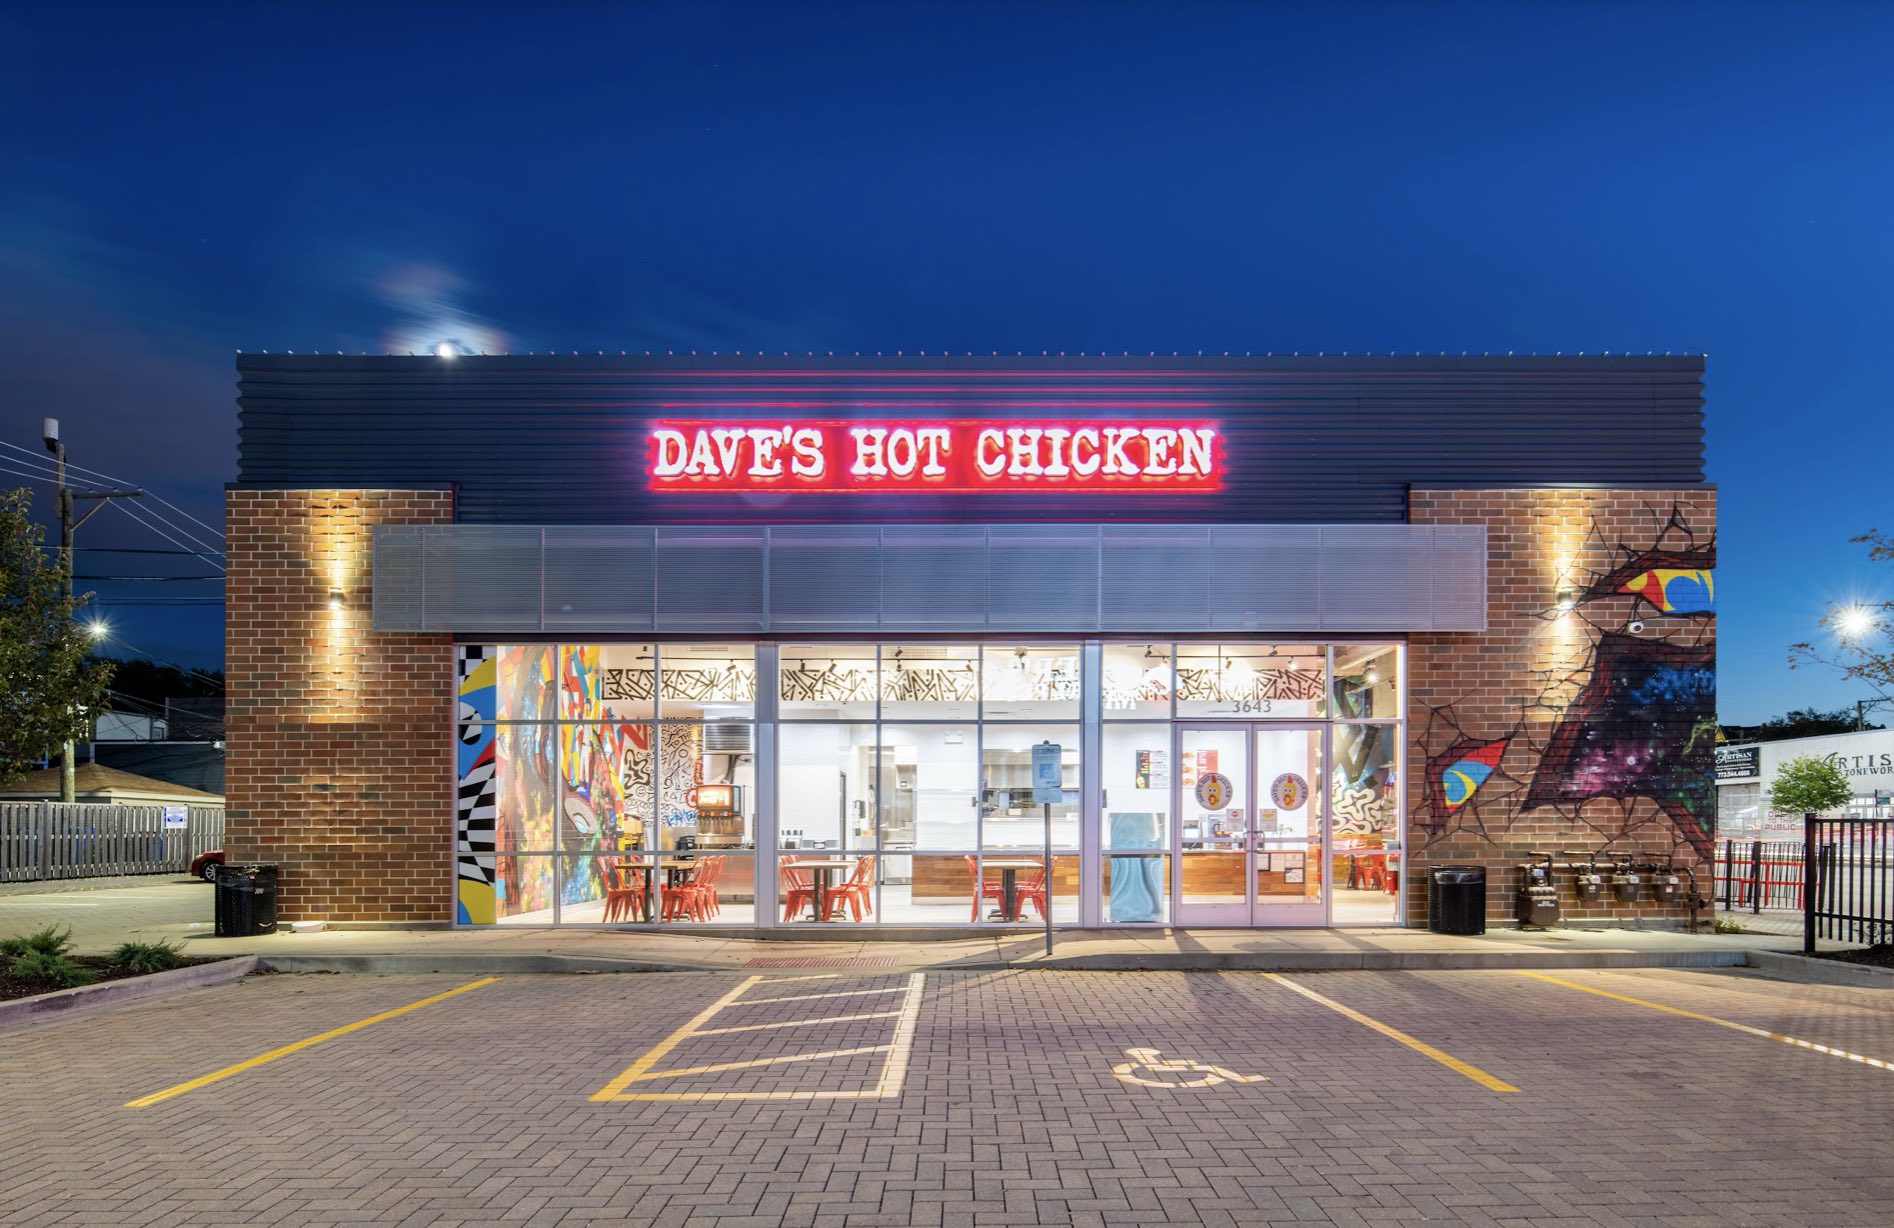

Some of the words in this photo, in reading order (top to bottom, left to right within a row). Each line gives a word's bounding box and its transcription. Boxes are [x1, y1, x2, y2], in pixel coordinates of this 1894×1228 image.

[653, 425, 825, 478] DAVE'S
[850, 428, 951, 478] HOT
[975, 428, 1216, 478] CHICKEN
[1232, 700, 1271, 713] 3643
[1764, 823, 1796, 831] PUBLIC
